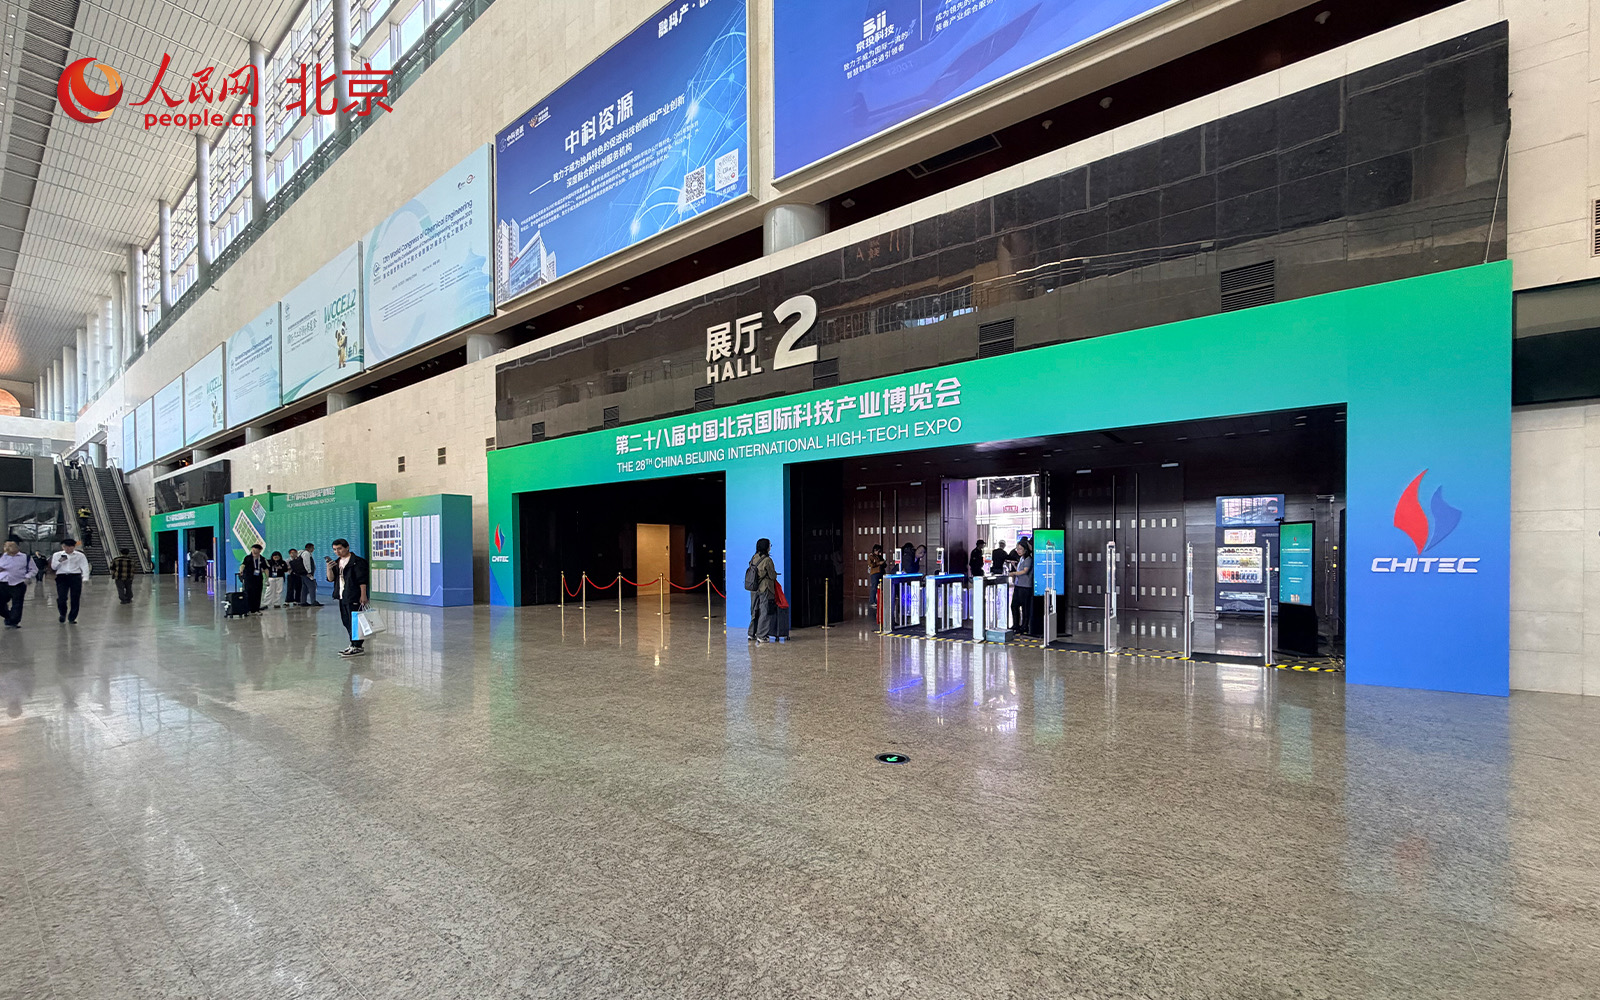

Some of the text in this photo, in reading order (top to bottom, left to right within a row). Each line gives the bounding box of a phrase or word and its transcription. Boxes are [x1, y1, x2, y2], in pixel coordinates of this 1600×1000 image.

[843, 30, 909, 71] 致力于成为国际一流的
[846, 43, 905, 80] 智慧轨道交通引领者
[856, 23, 895, 53] 京投科技
[564, 90, 634, 154] 中科资源
[566, 142, 633, 189] 深度融合的科创服务机构
[401, 235, 420, 252] Congress
[424, 217, 445, 236] Chemical
[445, 199, 473, 223] Engineering
[324, 288, 357, 324] WCCE12
[706, 311, 763, 362] 展厅
[773, 294, 819, 371] 2
[706, 355, 763, 385] HALL
[615, 377, 962, 456] 第二十八届中国北京国际科技产业博览会
[617, 416, 962, 474] THE 28TH CHINA BEIJING INTERNATIONAL HIGH-TECH EXPO
[1371, 557, 1481, 574] CHITEC
